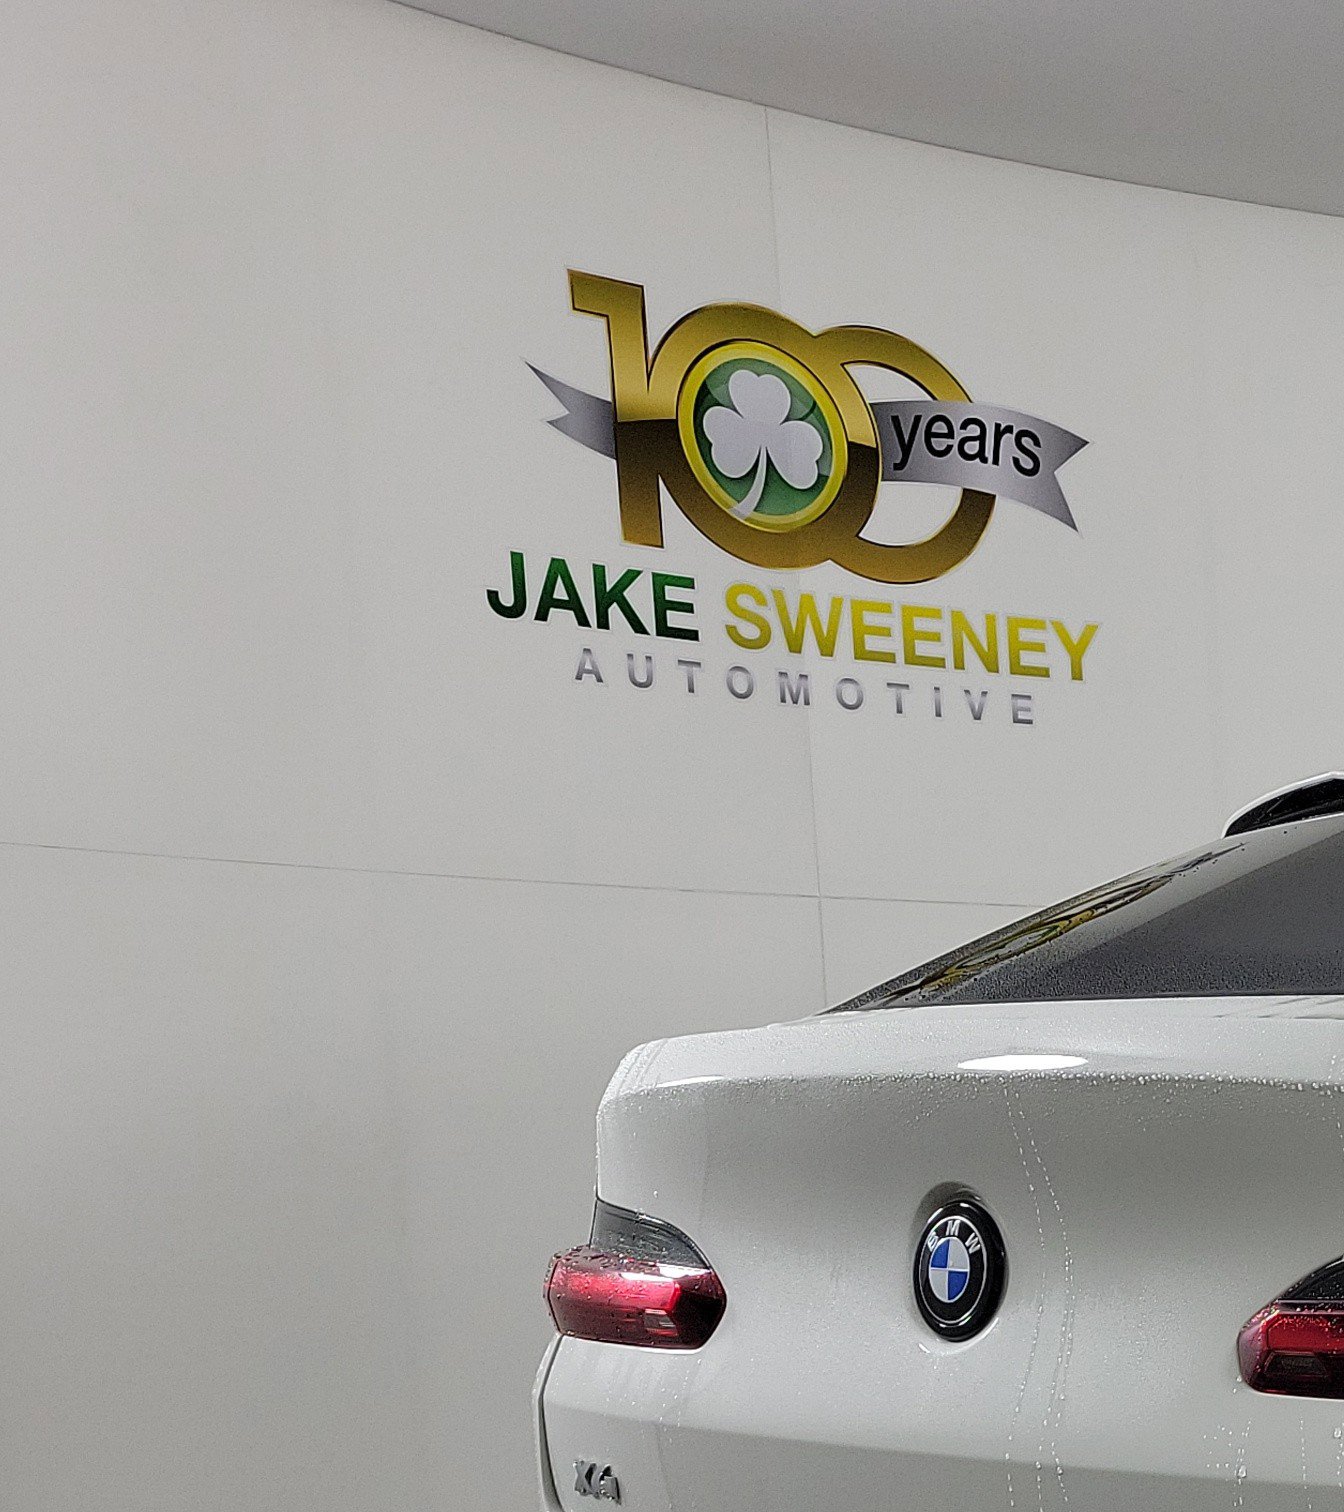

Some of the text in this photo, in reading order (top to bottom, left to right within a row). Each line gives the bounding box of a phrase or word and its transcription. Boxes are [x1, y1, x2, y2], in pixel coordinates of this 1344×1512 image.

[890, 411, 1043, 478] years
[486, 551, 1100, 682] JAKE SWEENEY
[574, 648, 1034, 725] AUTOMOTIVE
[927, 1219, 981, 1254] BMW
